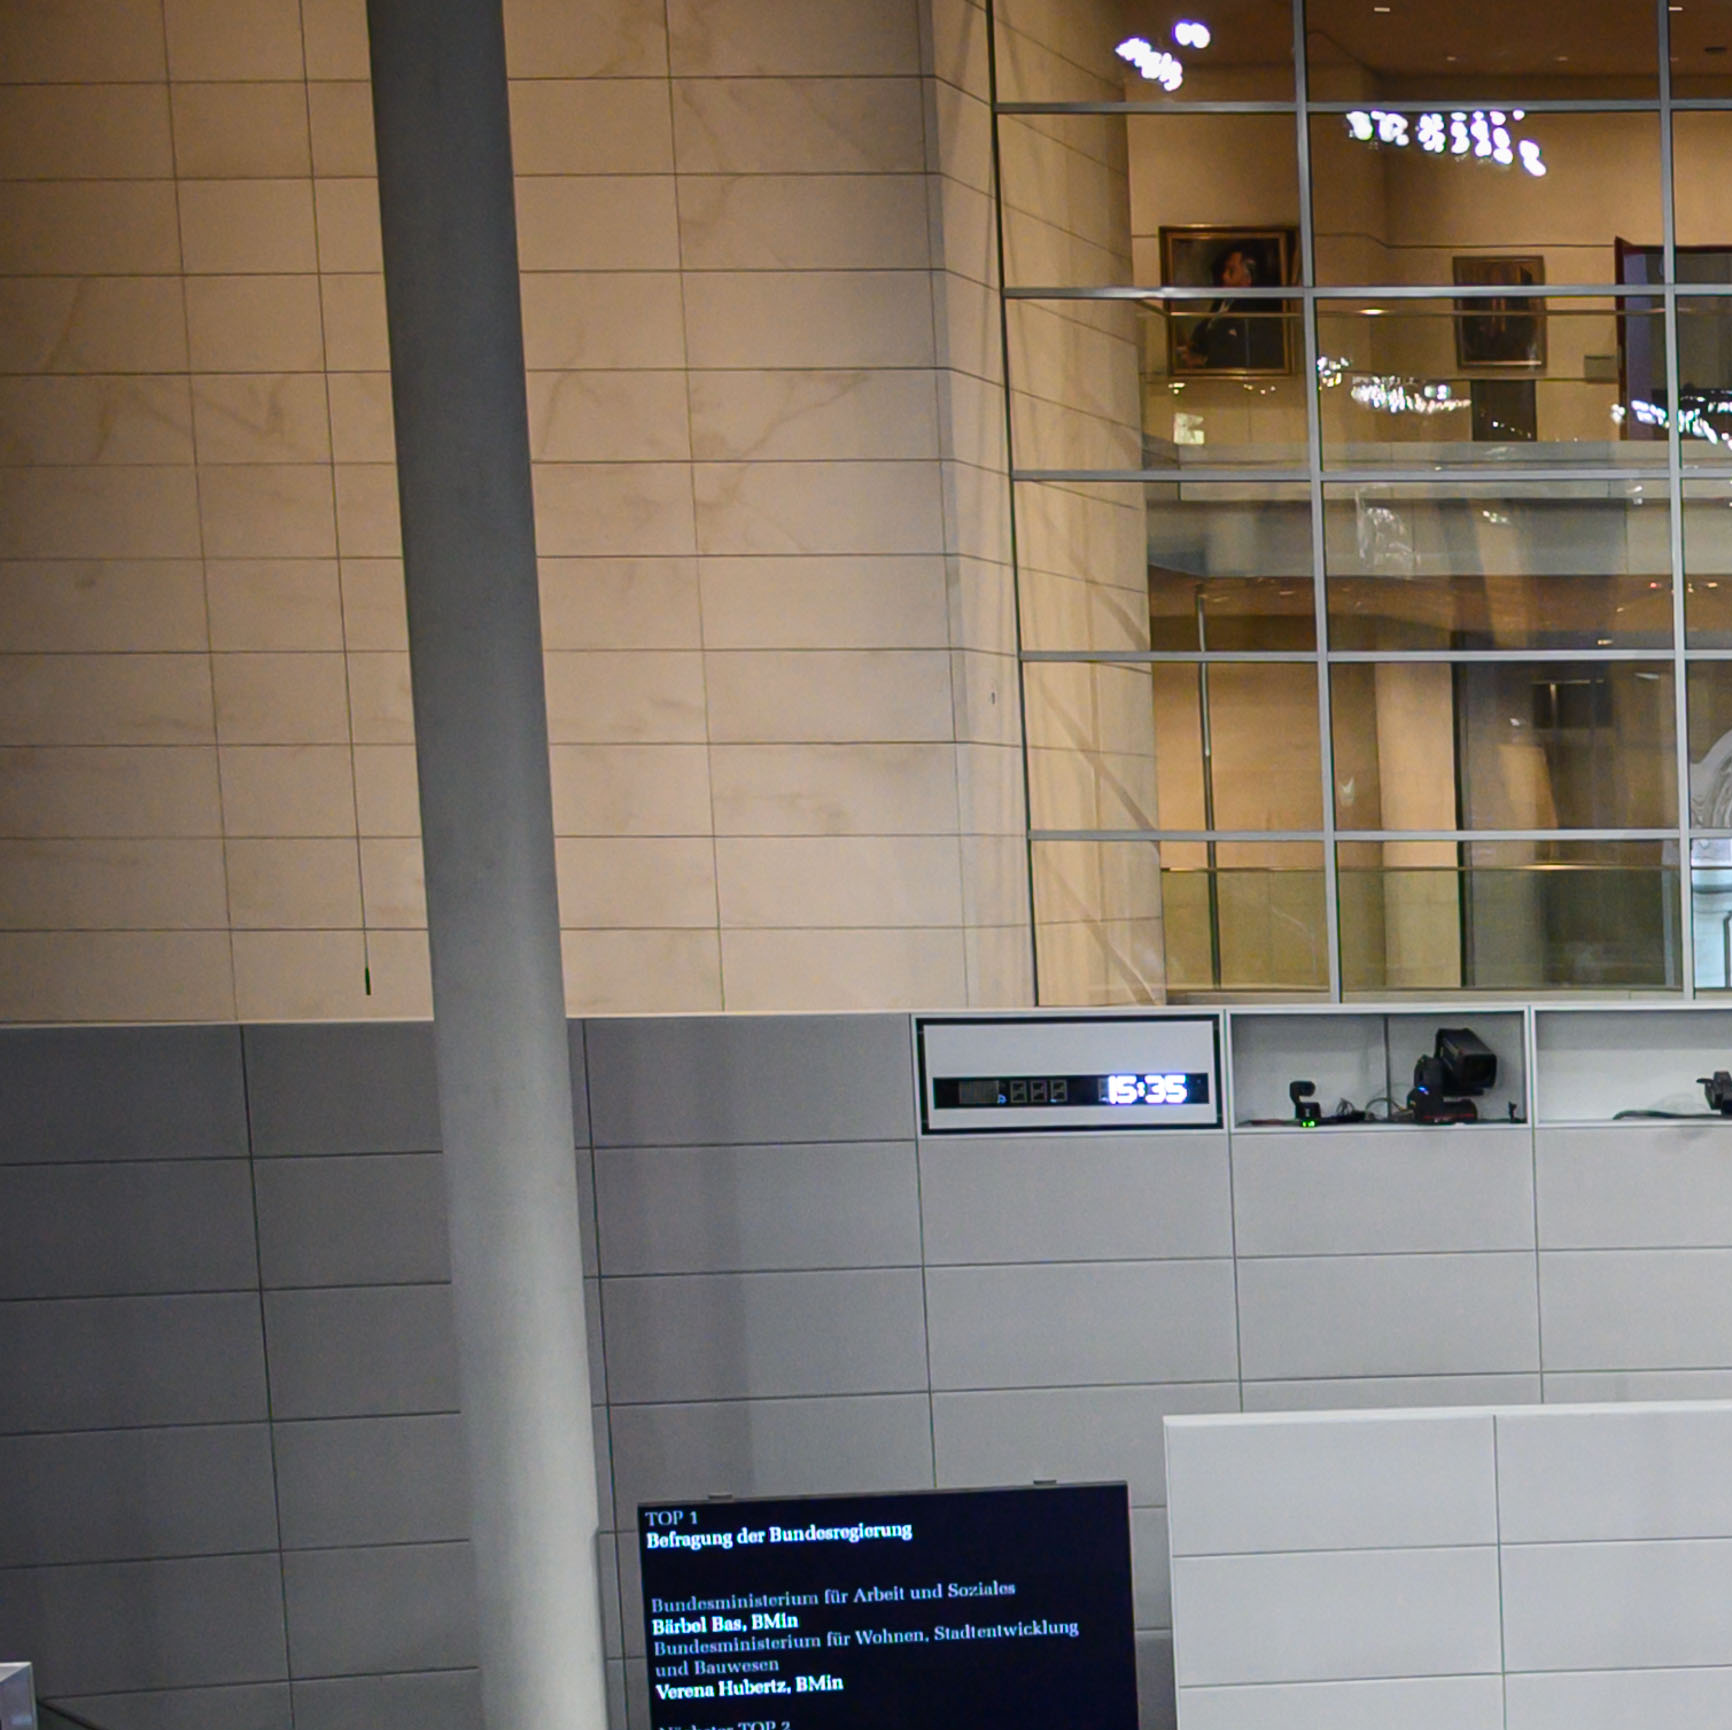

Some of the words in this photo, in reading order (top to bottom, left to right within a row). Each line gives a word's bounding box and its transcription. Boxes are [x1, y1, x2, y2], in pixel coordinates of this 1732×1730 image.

[645, 1511, 684, 1526] TOP
[690, 1511, 698, 1525] 1
[646, 1530, 733, 1550] Befragung
[736, 1527, 766, 1544] der
[769, 1523, 912, 1542] Bundesregierung
[652, 1593, 819, 1613] Bundesministerium
[824, 1589, 848, 1604] für
[853, 1585, 905, 1603] Arbeit
[910, 1583, 943, 1600] und
[947, 1580, 1016, 1598] Soziales
[652, 1617, 707, 1636] Bärbel
[712, 1616, 747, 1633] Bas,
[751, 1613, 799, 1631] BMin
[653, 1635, 821, 1656] Bundesministerium
[826, 1631, 851, 1647] für
[934, 1620, 1079, 1640] Stadtentwicklung
[655, 1660, 690, 1677] und
[694, 1659, 779, 1676] Bauwesen
[656, 1681, 715, 1700] Verena
[719, 1678, 792, 1698] Hubertz,
[795, 1674, 844, 1693] BMin
